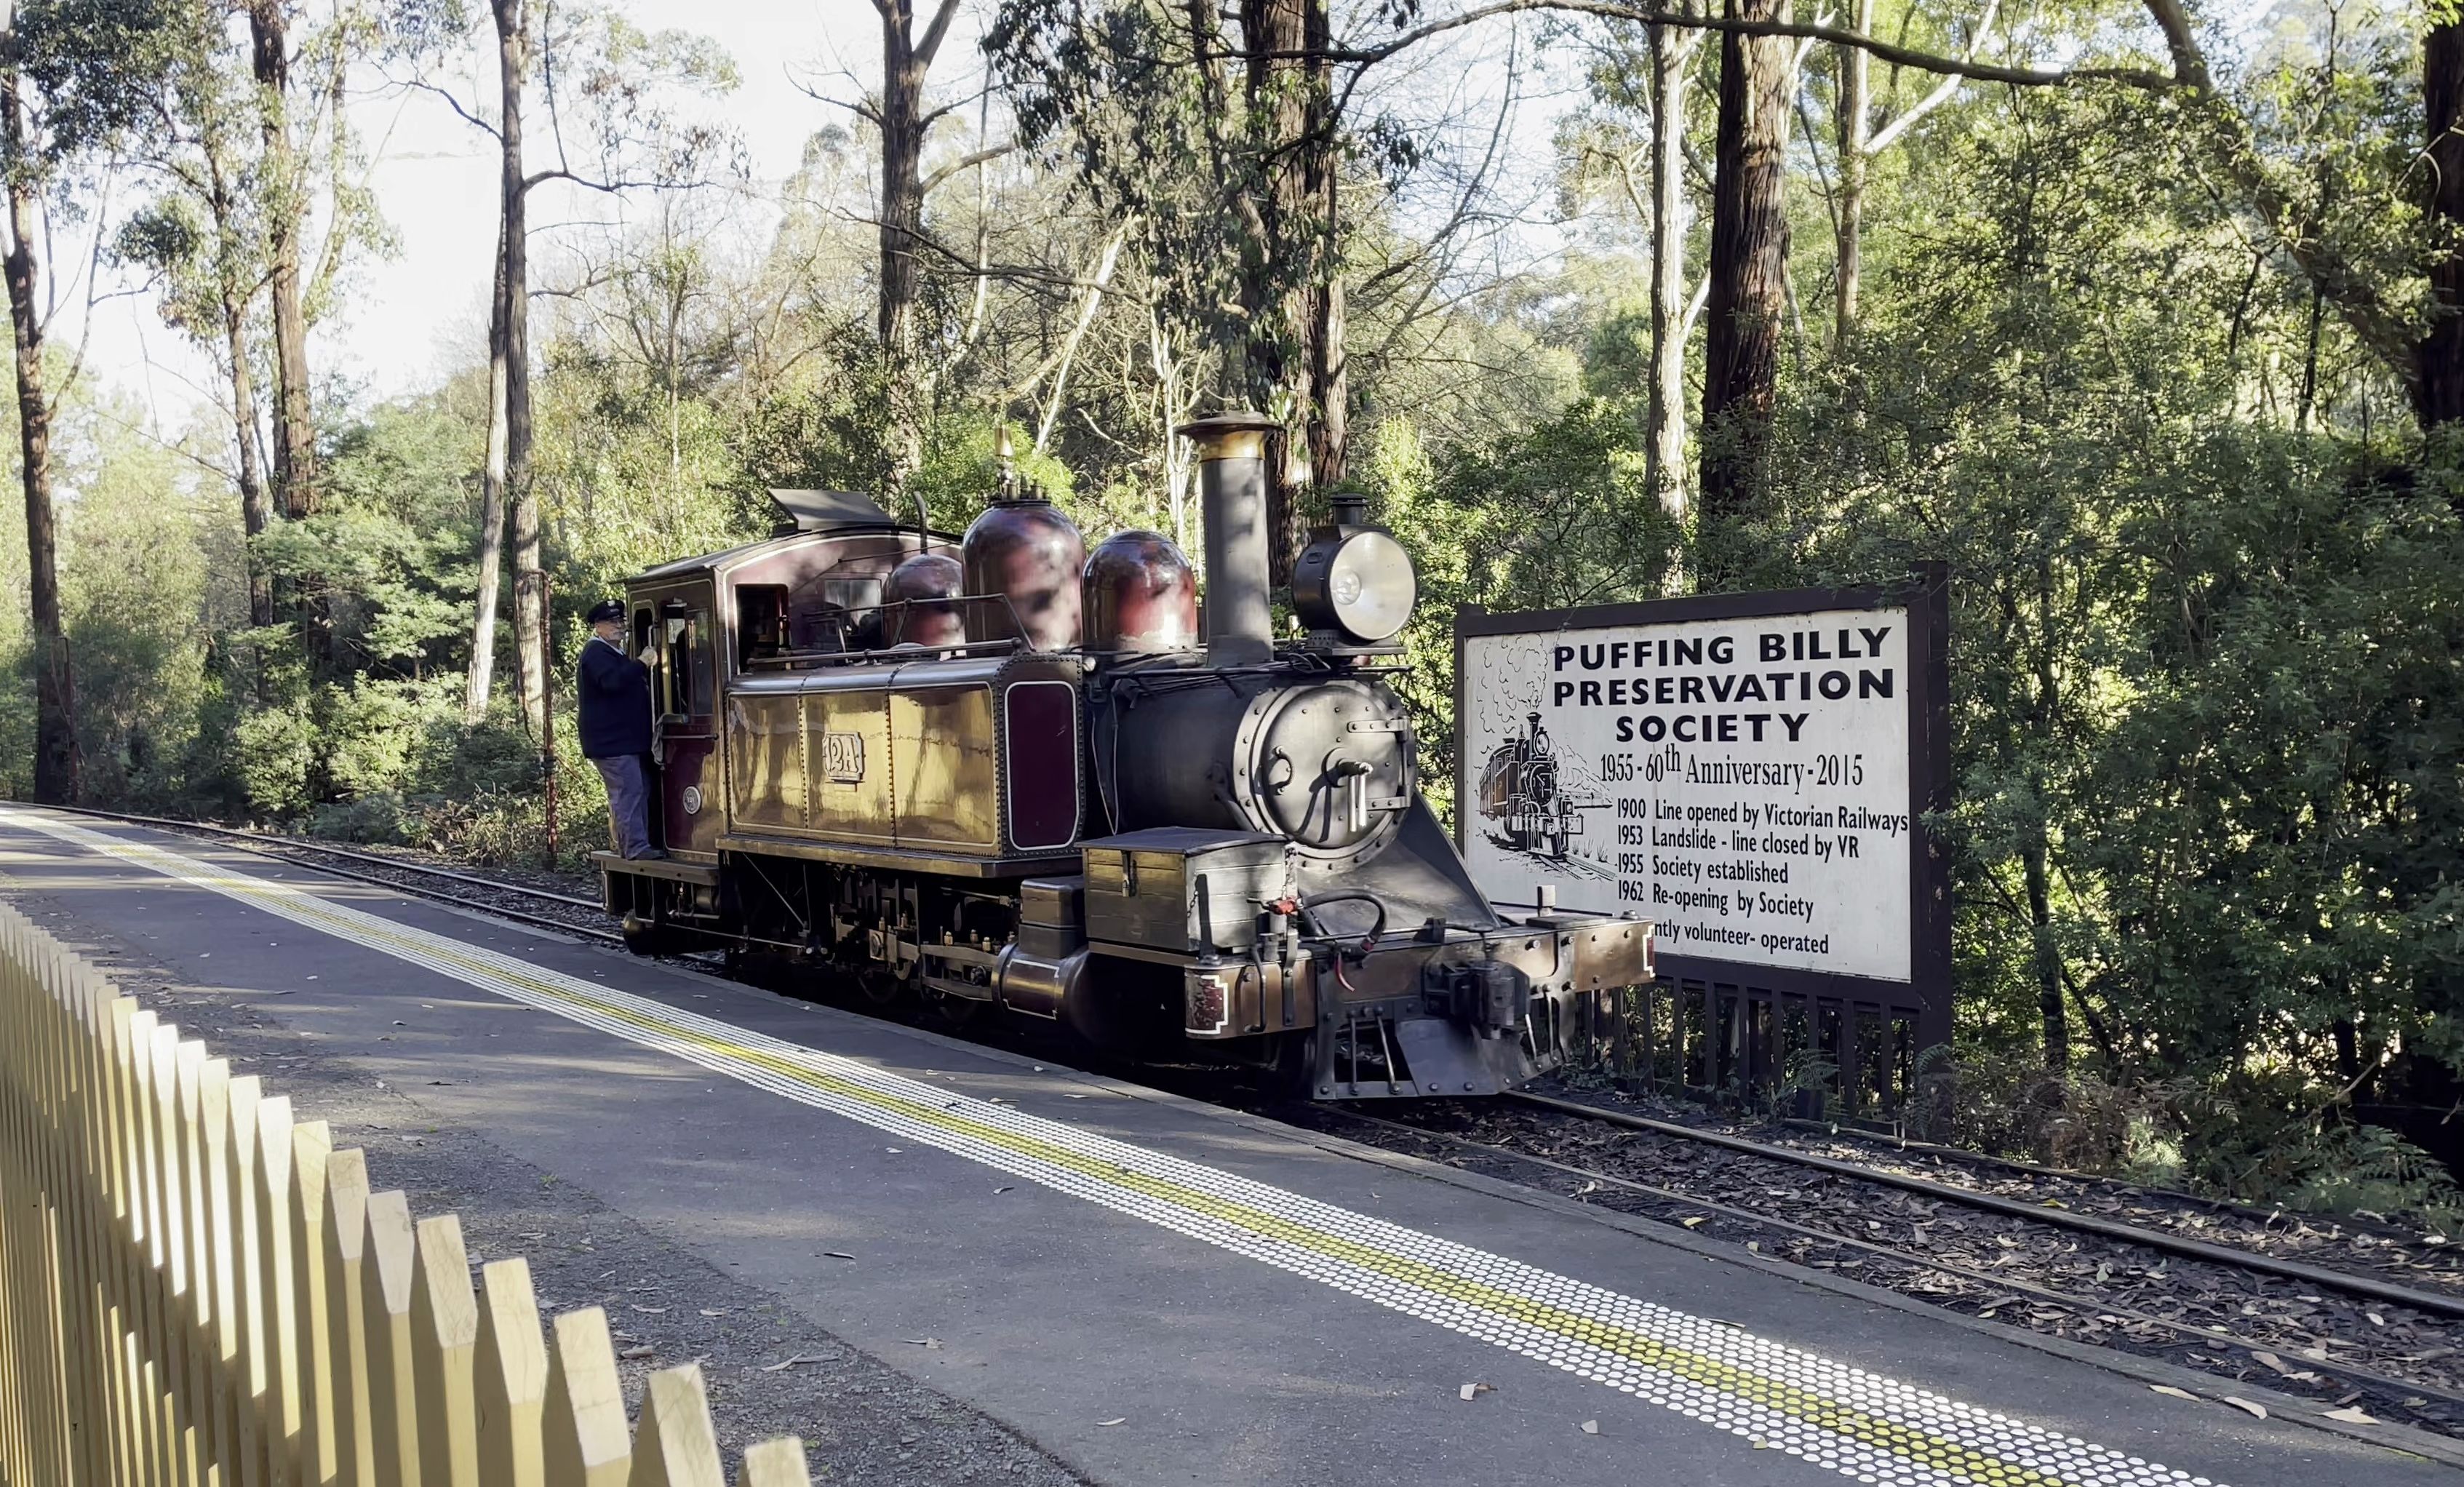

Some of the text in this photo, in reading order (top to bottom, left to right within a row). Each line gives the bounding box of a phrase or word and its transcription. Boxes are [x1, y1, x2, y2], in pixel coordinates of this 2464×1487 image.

[1554, 626, 1891, 671] PUFFING BILLY
[1554, 669, 1893, 706] PRESERVATION
[1616, 713, 1810, 742] SOCIETY
[1601, 754, 1633, 781] 1955
[1686, 754, 1804, 794] Anniversary
[1817, 754, 1862, 786] 2015
[1618, 798, 1908, 837] 1900 Line opened by Victorian Railways
[1618, 824, 1643, 845] 1953
[1652, 826, 1716, 849] Landslide
[1732, 830, 1757, 852] line
[1762, 832, 1809, 855] closed
[1815, 834, 1833, 863] by
[1838, 835, 1859, 858] VR
[1618, 853, 1789, 884] 1955 Society established
[1618, 880, 1814, 924] 1962 Re-opening by Society
[1761, 933, 1829, 954] operated
